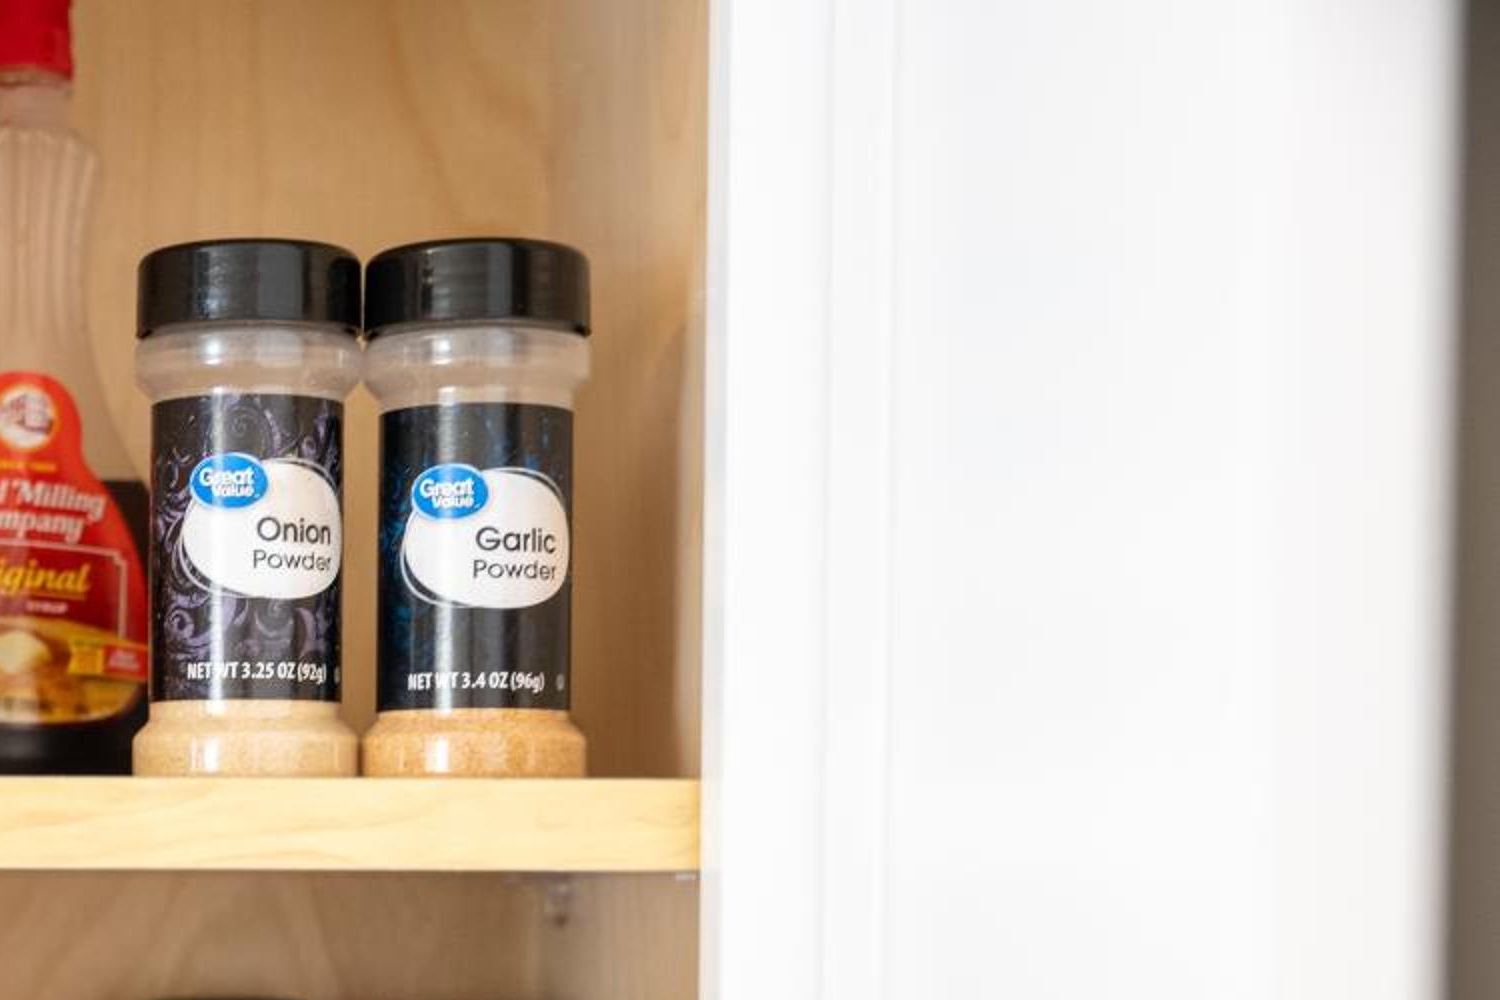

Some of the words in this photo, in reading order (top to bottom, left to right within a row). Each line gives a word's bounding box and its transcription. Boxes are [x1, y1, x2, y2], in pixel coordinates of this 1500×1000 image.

[199, 468, 254, 488] Great
[419, 477, 474, 497] Great
[213, 482, 254, 497] Value
[12, 479, 107, 522] Milling
[431, 494, 474, 509] Value
[257, 517, 331, 544] Onion
[475, 526, 556, 554] Garlic
[253, 549, 331, 571] Powder
[472, 559, 556, 580] Powder
[187, 662, 212, 681] NET
[241, 662, 274, 680] 3.25
[277, 661, 295, 679] OZ
[298, 662, 328, 684] (92g)
[407, 672, 431, 690] NET
[461, 672, 486, 689] 3.4
[488, 672, 508, 689] OZ
[510, 672, 545, 693] (96g)
